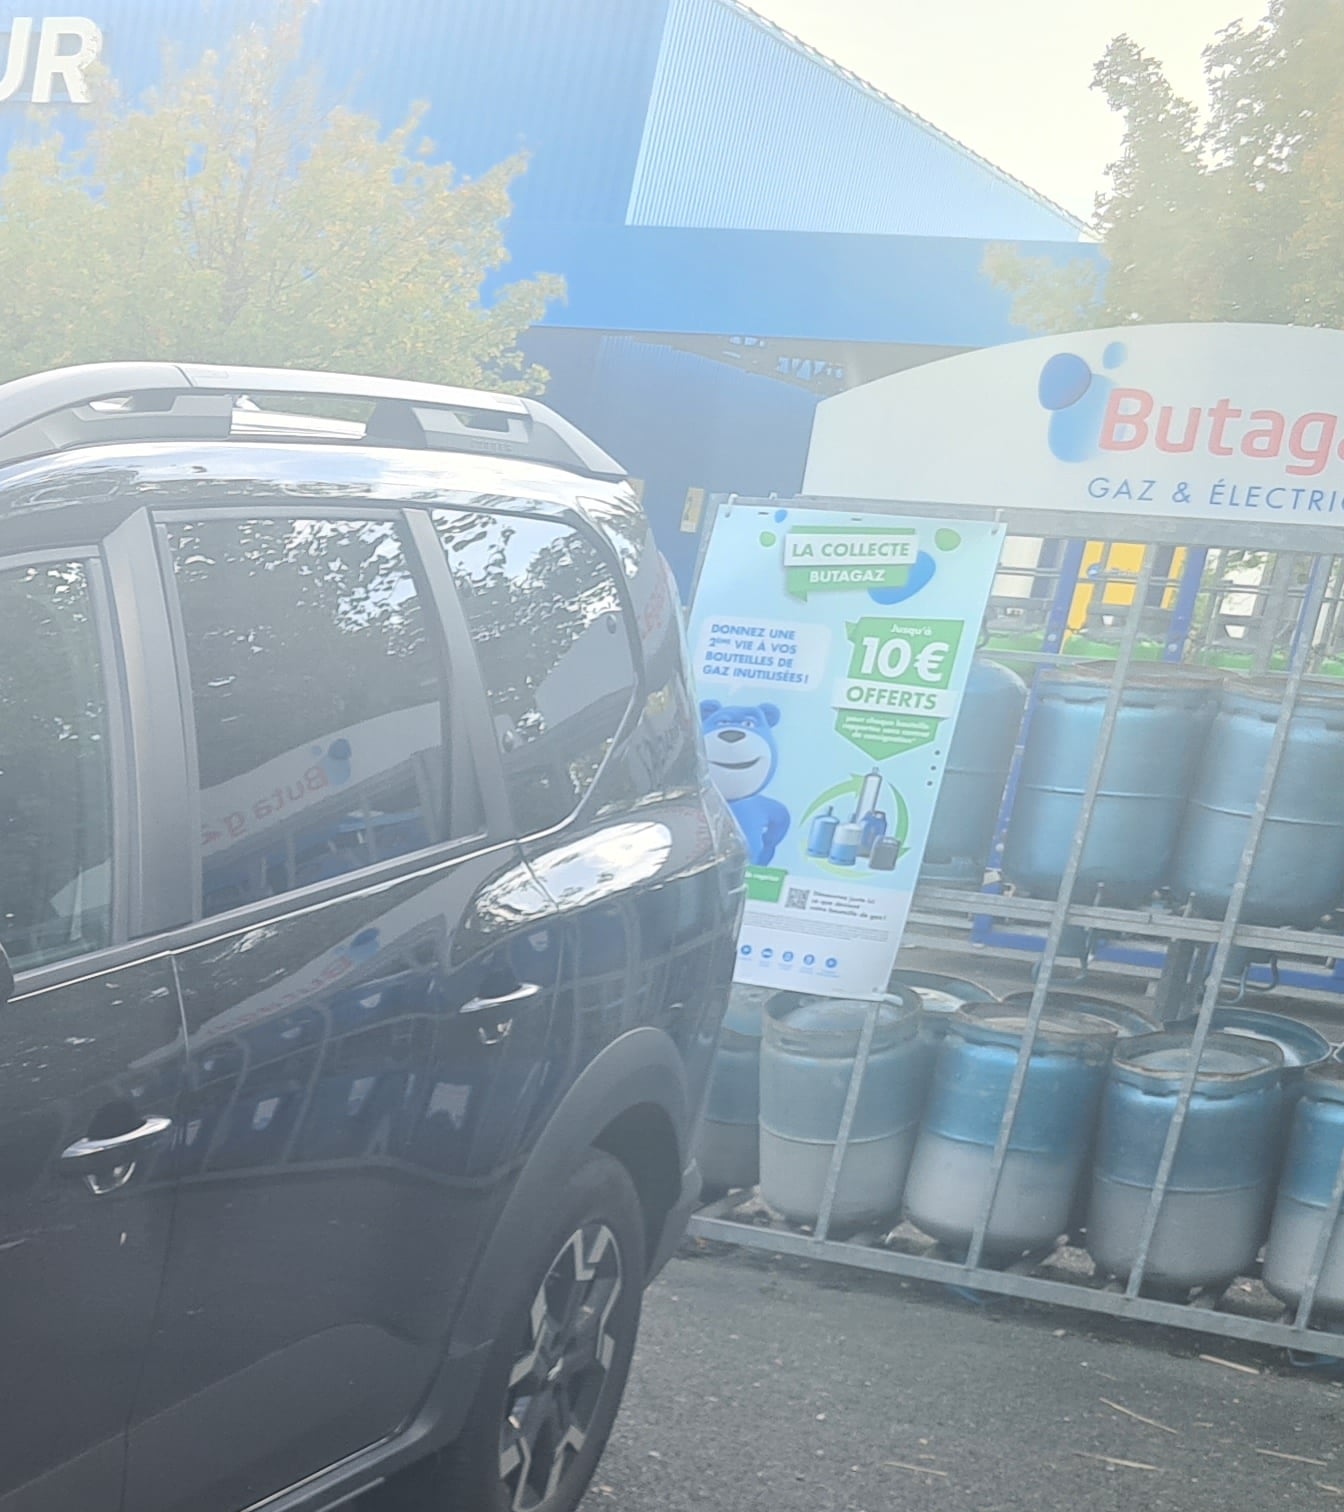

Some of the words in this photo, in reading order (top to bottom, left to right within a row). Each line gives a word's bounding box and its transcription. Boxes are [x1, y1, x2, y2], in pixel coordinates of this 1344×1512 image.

[1098, 387, 1344, 476] Butag
[1087, 477, 1156, 502] GAZ
[1171, 481, 1192, 504] &
[792, 543, 814, 557] LA
[821, 542, 910, 557] COLLECTE
[809, 569, 886, 582] BUTAGAZ
[711, 623, 766, 637] DONNEZ
[769, 629, 796, 640] UNE
[735, 639, 753, 651] VIE
[772, 643, 798, 655] VOS
[705, 651, 774, 666] BOUTEILLES
[778, 658, 793, 668] DE
[703, 665, 731, 676] GAZ
[846, 686, 938, 710] OFFERTS
